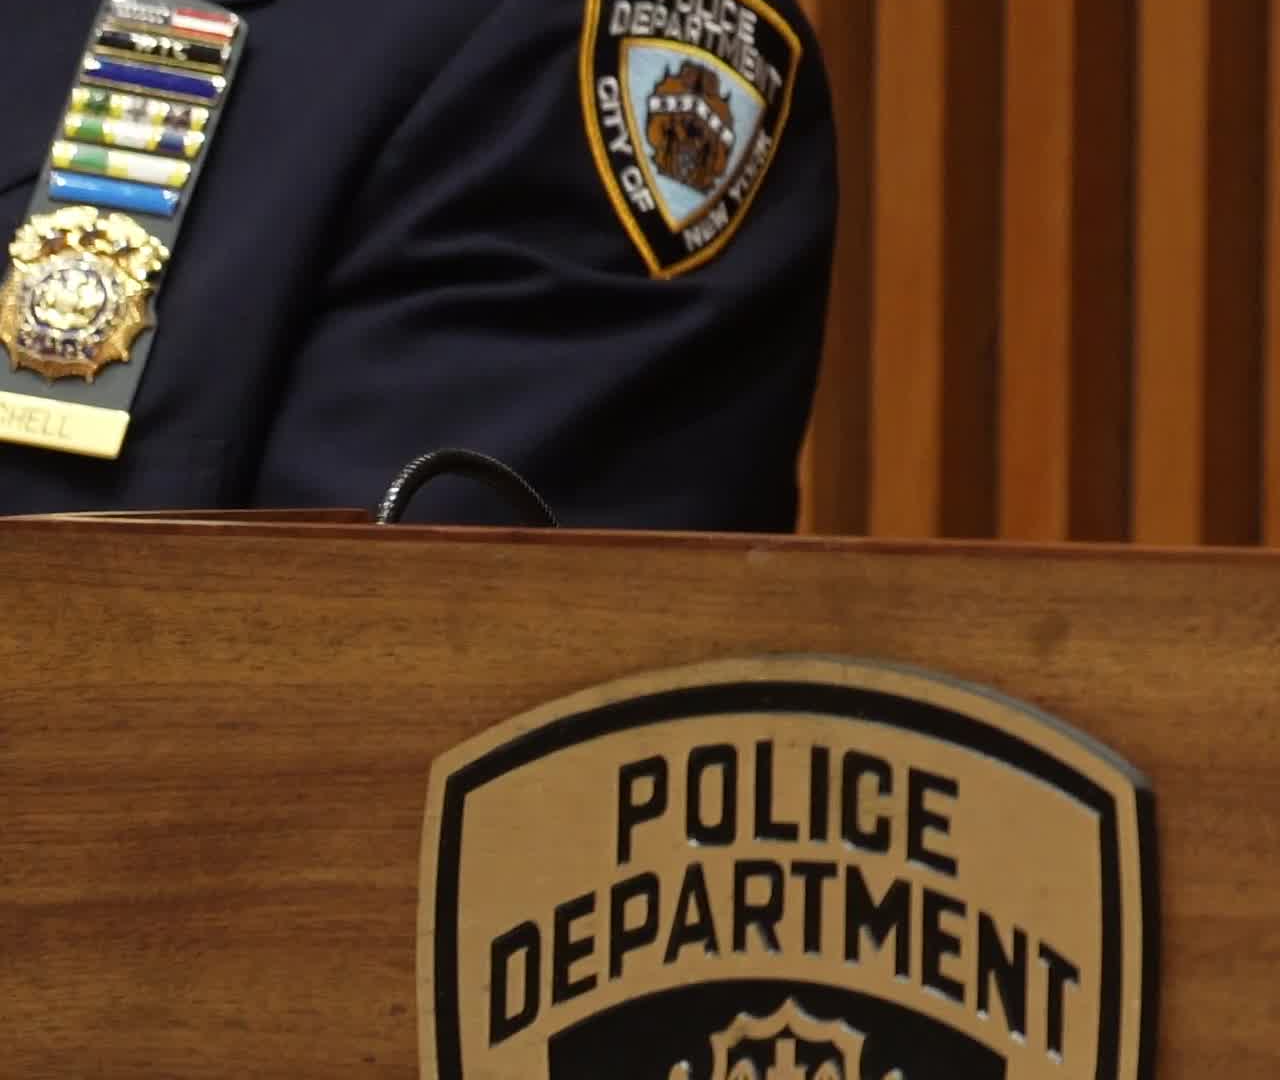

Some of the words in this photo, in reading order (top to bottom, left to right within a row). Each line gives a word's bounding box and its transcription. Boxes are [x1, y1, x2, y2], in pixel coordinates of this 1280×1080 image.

[609, 0, 783, 102] DEPARTMENT
[597, 75, 633, 155] CITY
[620, 164, 656, 214] OF
[682, 200, 729, 252] NEW
[616, 739, 959, 877] POLICE
[487, 859, 1080, 1066] DEPARTMENT
